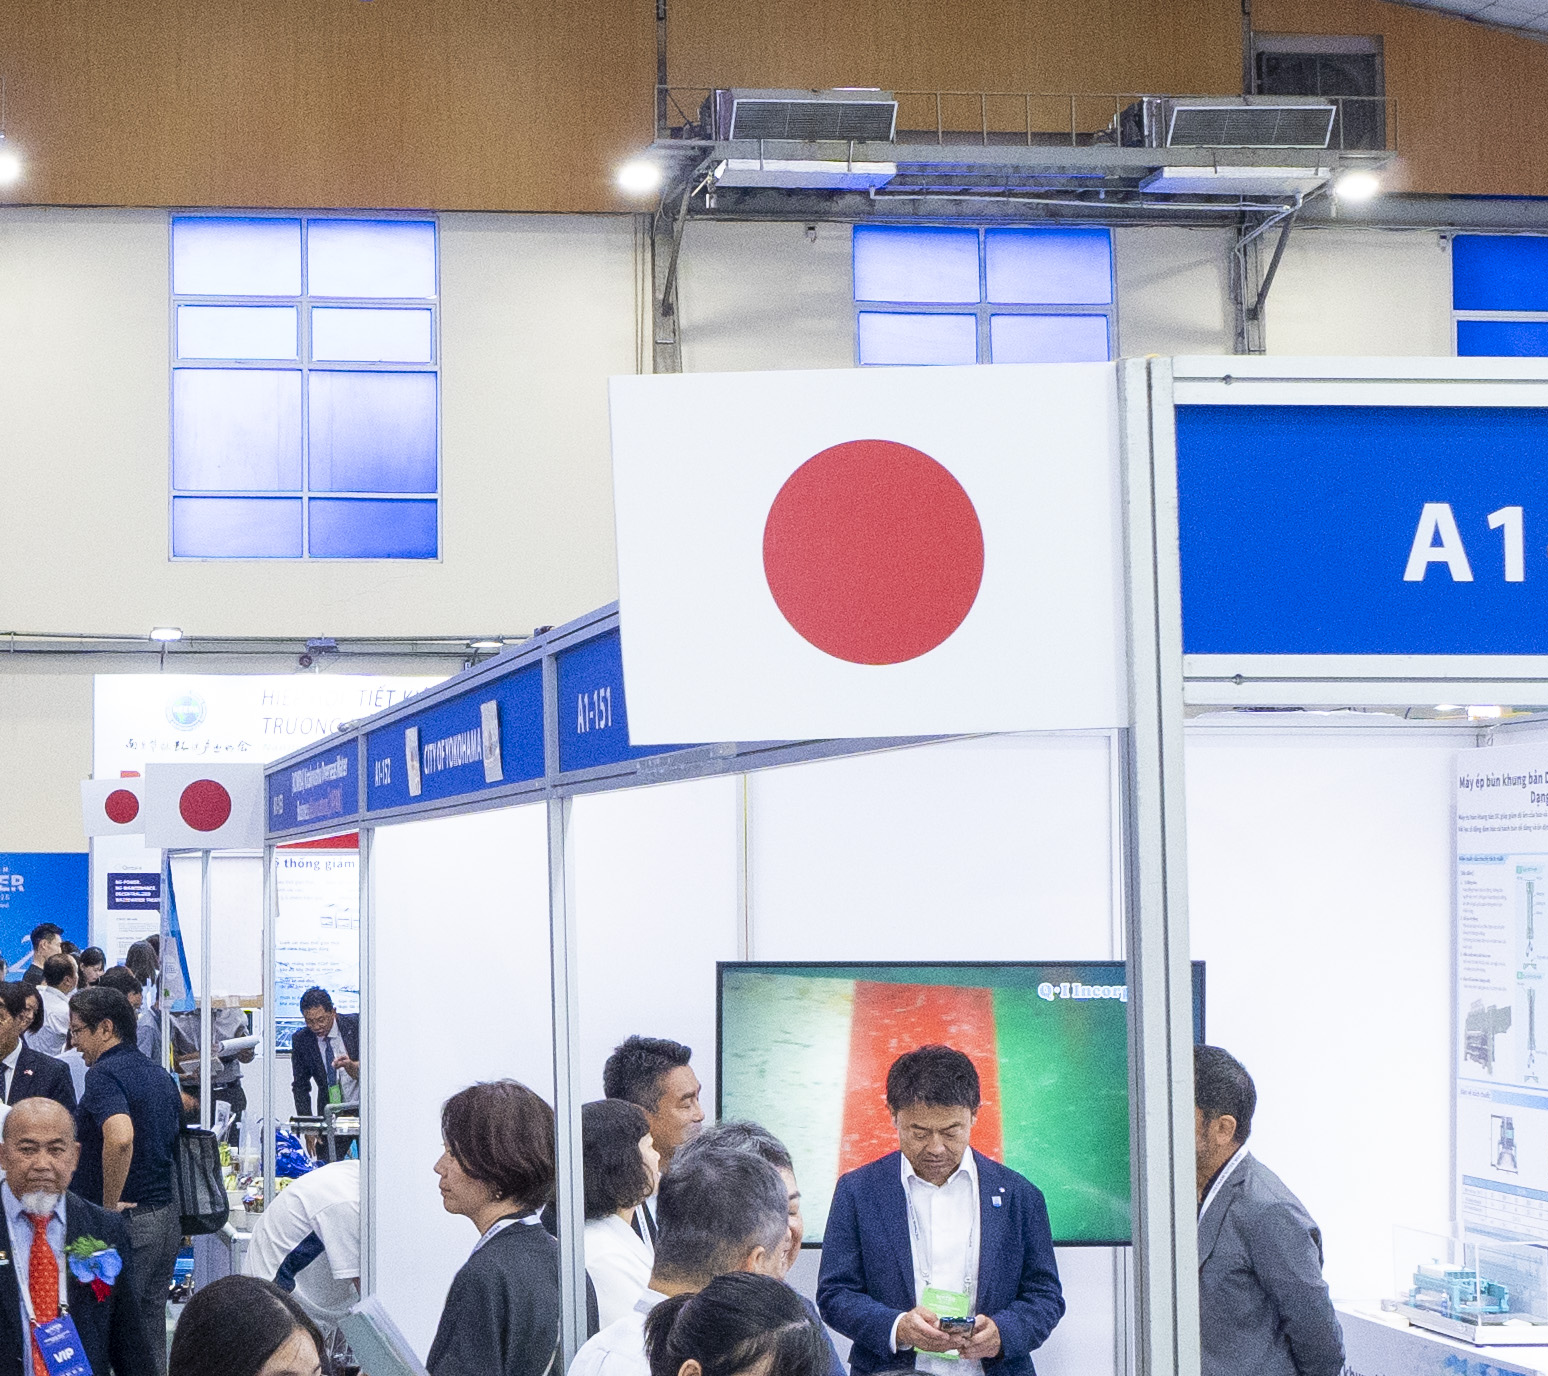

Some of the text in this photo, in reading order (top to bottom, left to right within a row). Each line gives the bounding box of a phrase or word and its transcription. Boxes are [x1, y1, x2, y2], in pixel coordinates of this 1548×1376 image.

[578, 686, 612, 733] A1-151
[423, 729, 482, 775] CITY OF YOKOHAMA
[375, 758, 391, 787] A1-152
[53, 1347, 74, 1363] VIP
